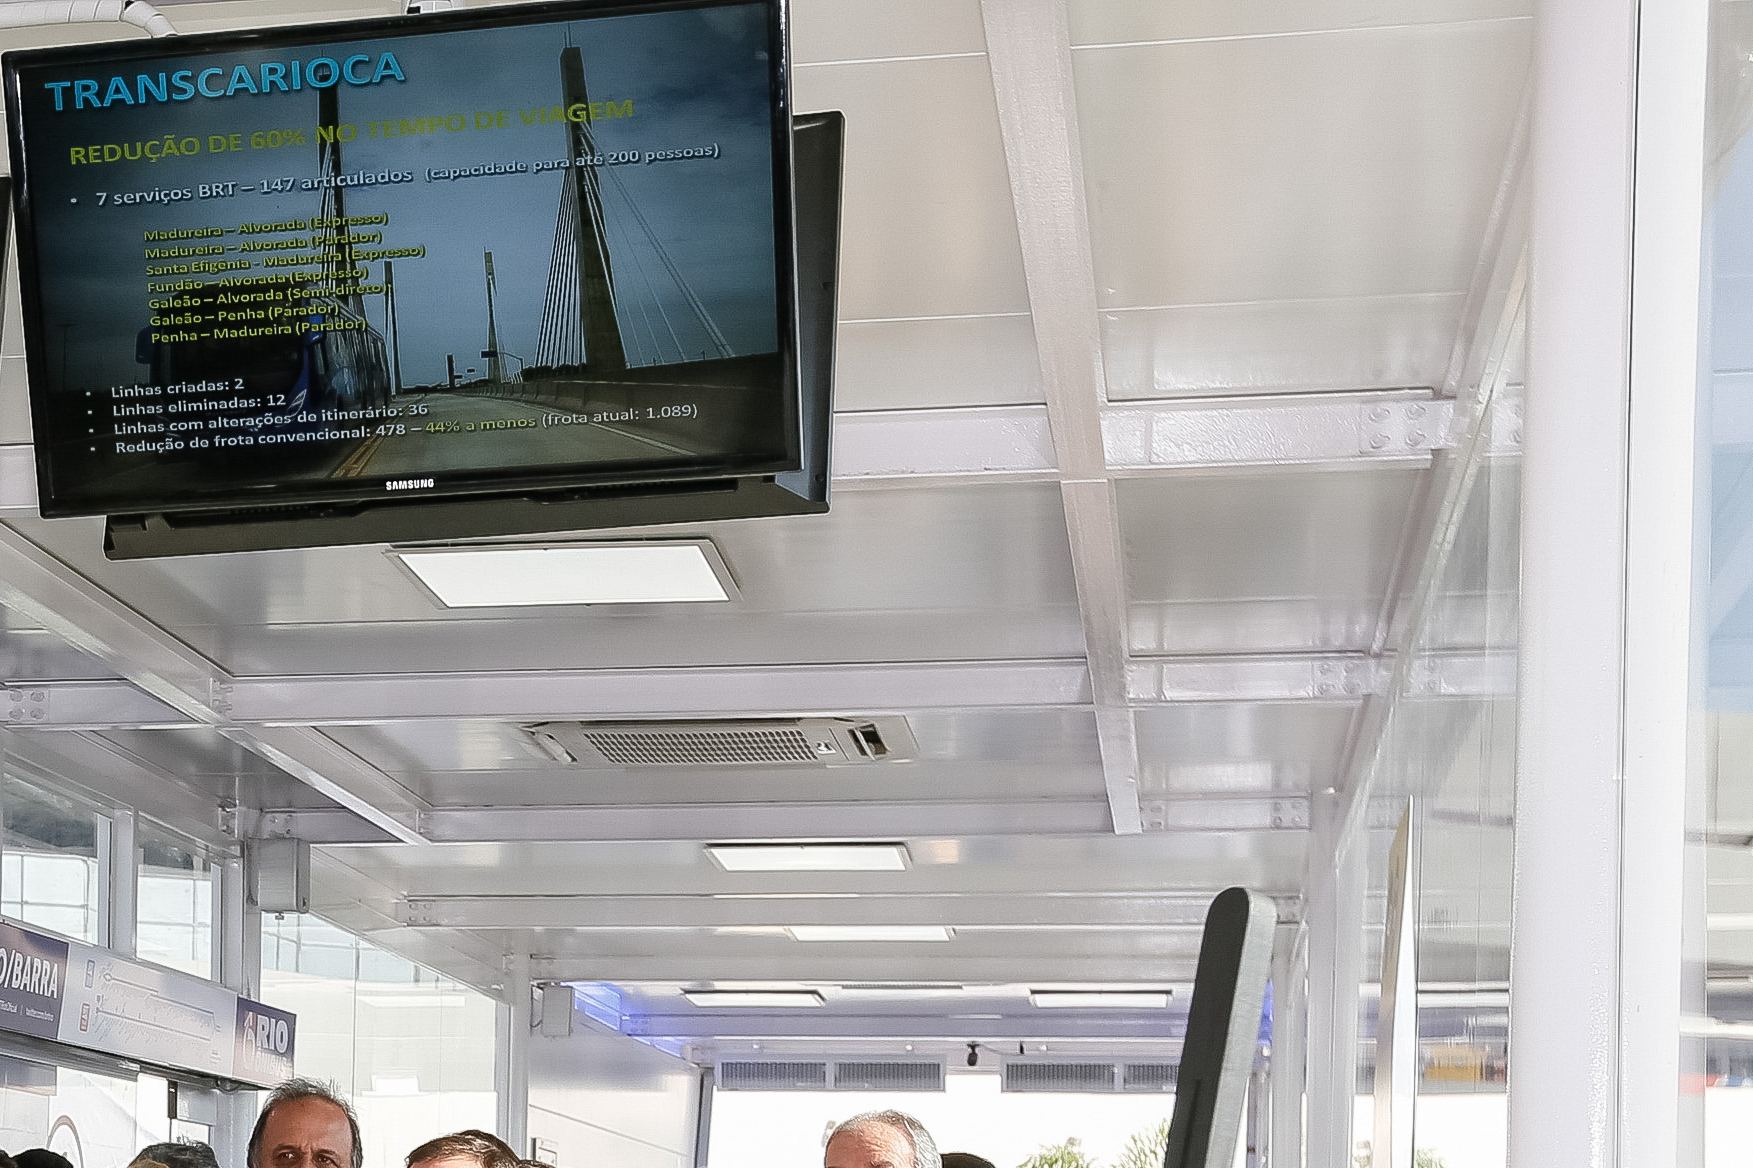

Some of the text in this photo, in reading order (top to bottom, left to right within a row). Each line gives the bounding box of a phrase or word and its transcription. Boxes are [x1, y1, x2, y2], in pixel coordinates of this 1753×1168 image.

[44, 51, 407, 112] TRANSCARIOCA
[69, 99, 635, 165] REDUÇÃO DE 60% NO TEMPO DE VIAGEM
[95, 142, 720, 206] 7 serviços BRT 147 articulados (capacidade para até 200 pessoas)
[144, 211, 389, 241] Madureira Alvorada (Expresso)
[146, 229, 384, 259] Madureira Alvorada (Parador)
[146, 263, 188, 276] Santa
[263, 252, 343, 267] Madureira
[346, 244, 427, 263] (Expresso)
[148, 266, 370, 293] Fundão Alvorada (Expresso)
[149, 296, 201, 310] Galeão
[216, 289, 284, 305] Alvorada
[150, 301, 341, 327] Galeão Penha (Parador)
[151, 316, 368, 344] Penha Madureira (Parador)
[111, 378, 245, 399] Linhas criadas: 2
[112, 393, 287, 418] Linhas eliminadas: 12
[114, 402, 428, 436] Linhas com alterações de itinerário: 36
[115, 403, 698, 454] Redução de frota convencional: 478 44% a menos (frota atual: 1.089)
[385, 478, 435, 491] SAMSUNG
[256, 1015, 289, 1054] RIO
